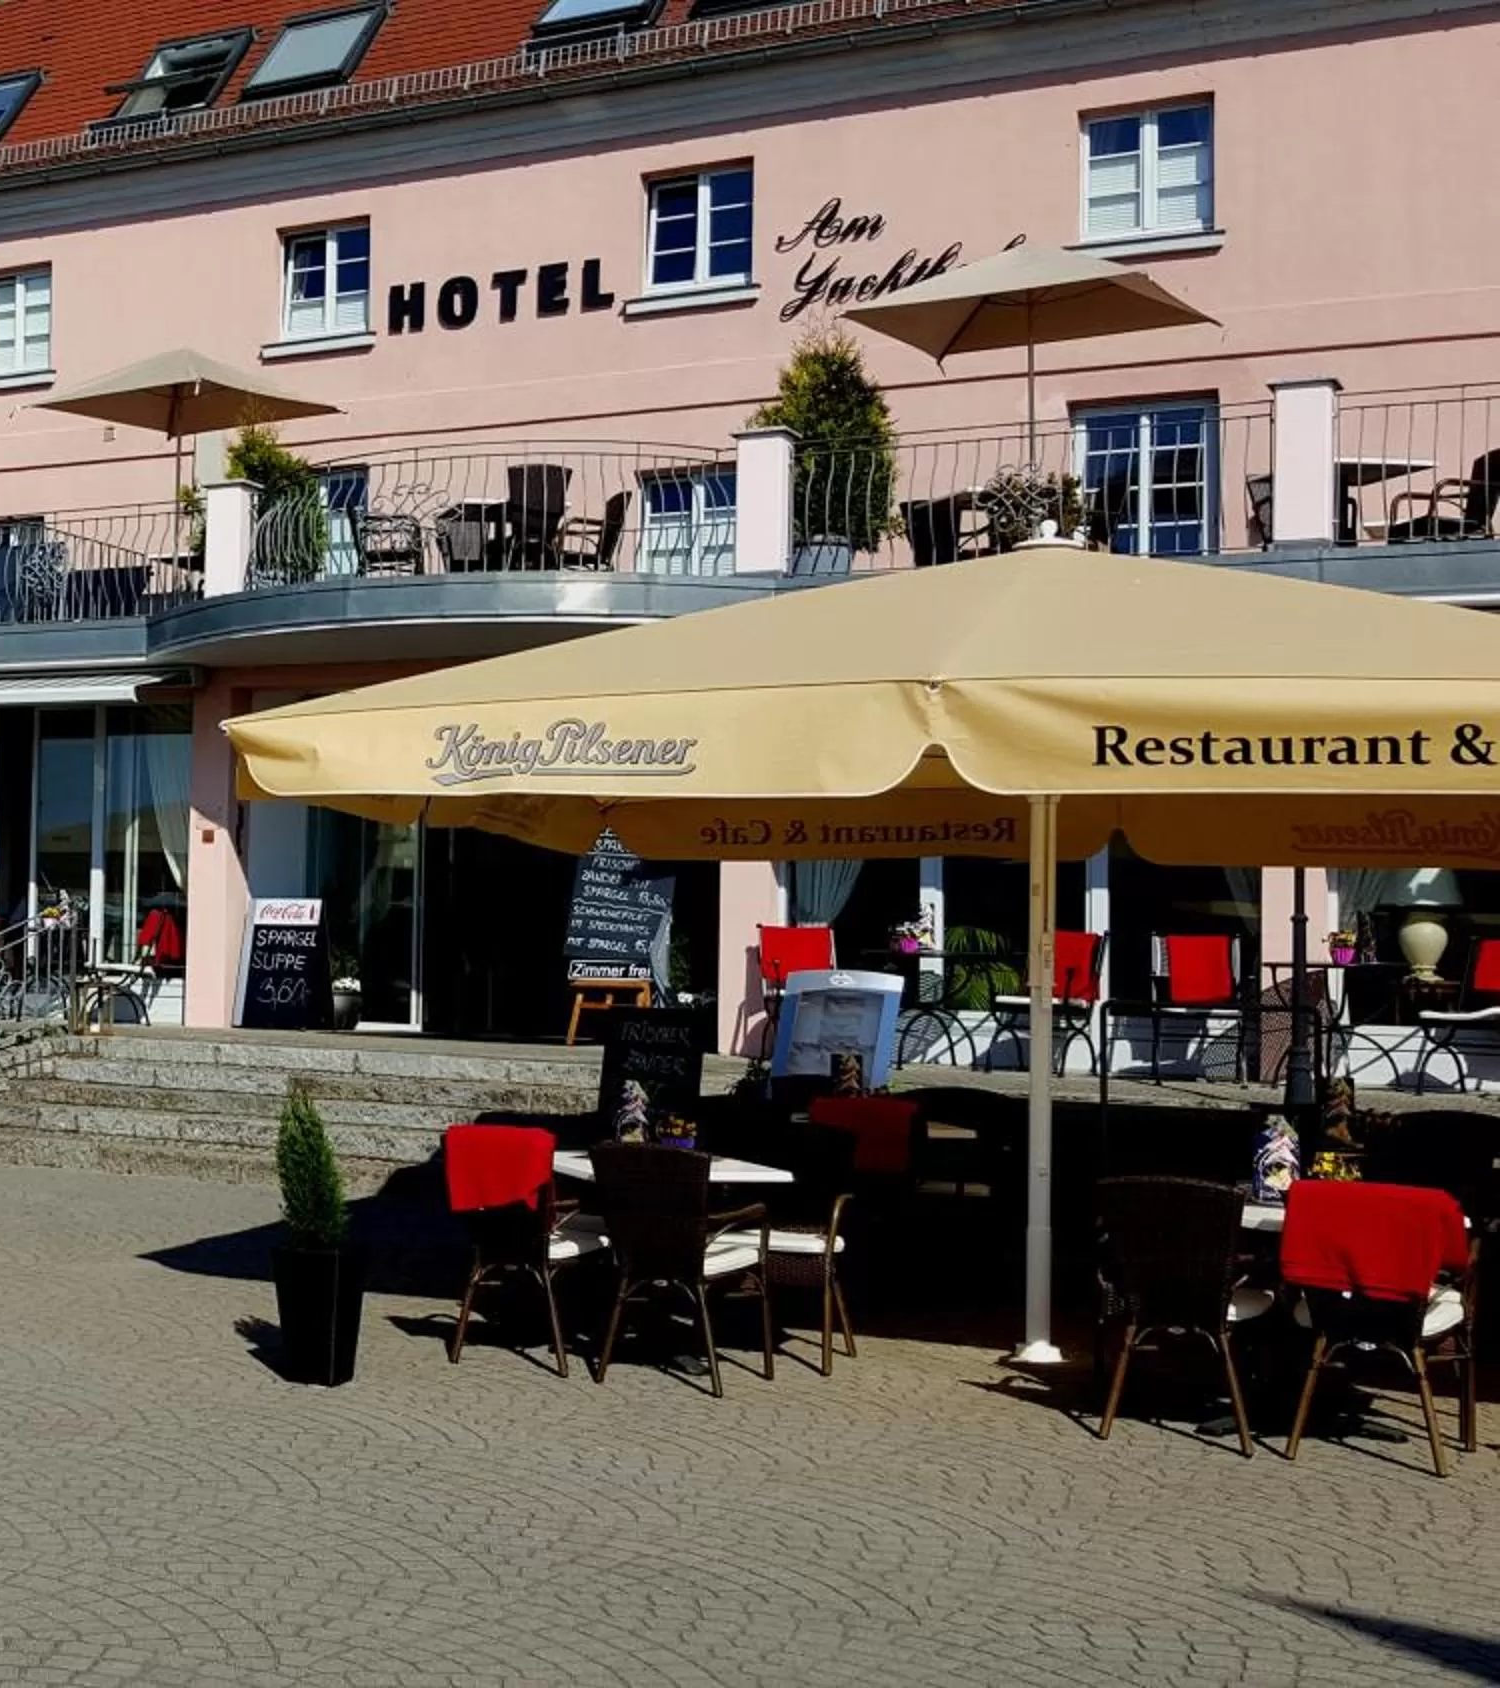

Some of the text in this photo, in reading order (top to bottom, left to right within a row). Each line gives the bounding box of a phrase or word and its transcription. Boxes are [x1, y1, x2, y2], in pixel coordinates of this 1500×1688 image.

[775, 198, 886, 253] Am
[388, 258, 615, 336] HOTEL
[425, 717, 698, 777] König Pilsener
[1092, 723, 1500, 767] Restaurant &
[252, 950, 307, 971] SUPPE
[256, 929, 317, 948] SPARGEL
[572, 963, 651, 979] Zimmer frei
